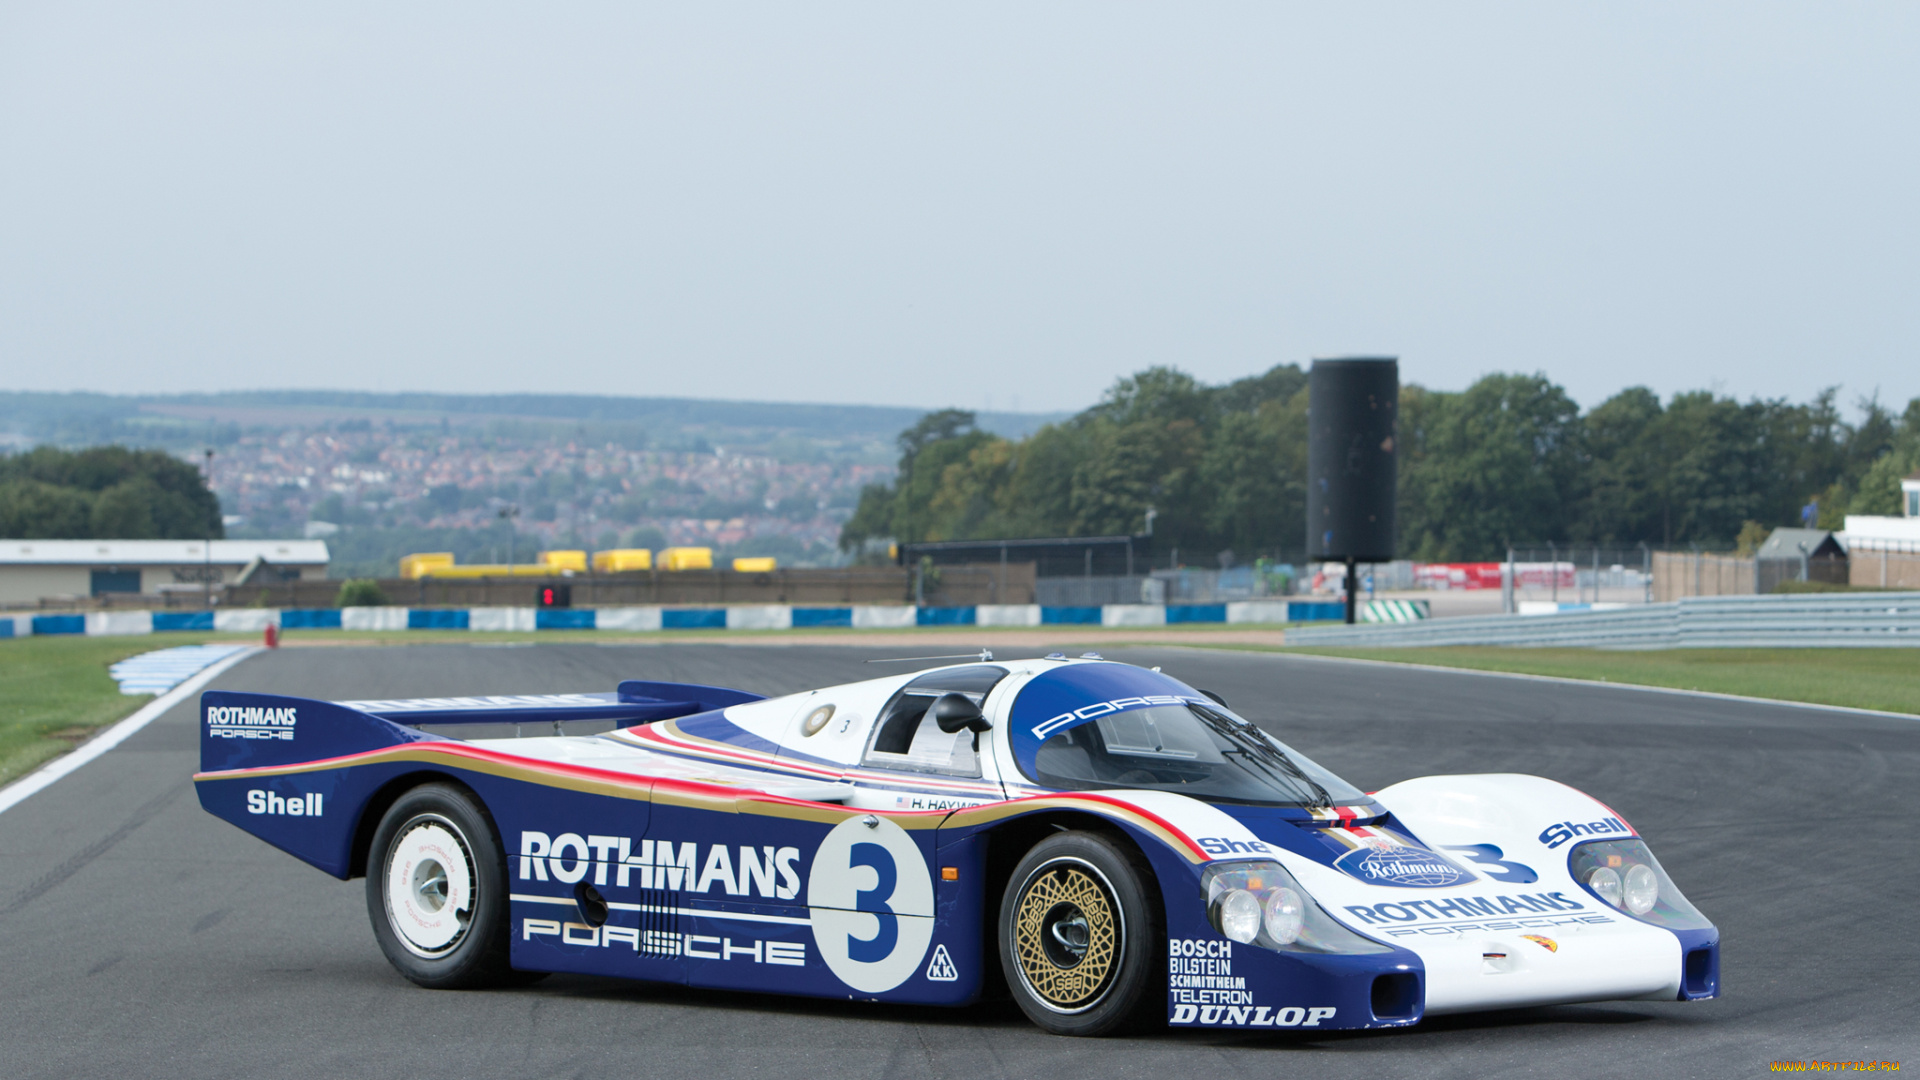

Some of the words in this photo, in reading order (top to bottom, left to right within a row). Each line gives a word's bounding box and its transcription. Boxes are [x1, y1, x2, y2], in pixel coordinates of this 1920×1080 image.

[207, 706, 297, 726] ROTHMANS
[840, 719, 851, 733] 3
[210, 729, 294, 740] PORSCHE
[247, 789, 323, 816] Shell
[911, 798, 925, 809] H.
[1538, 817, 1629, 849] Shell
[519, 830, 801, 900] ROTHMANS
[1359, 860, 1464, 879] Rothmans
[1435, 843, 1539, 884] 3
[847, 842, 899, 964] 3
[1343, 891, 1585, 924] ROTHMANS
[1024, 897, 1044, 935] BBS
[1384, 915, 1616, 938] PORSCHE
[523, 918, 806, 966] PORSCHE
[1169, 939, 1232, 958] BOSCH
[1169, 958, 1231, 975] BILSTEIN
[1056, 976, 1083, 991] BBS
[1170, 975, 1246, 989] SCHMITTHELM
[1170, 989, 1253, 1004] TELETRON
[1169, 1004, 1337, 1026] DUNLOP
